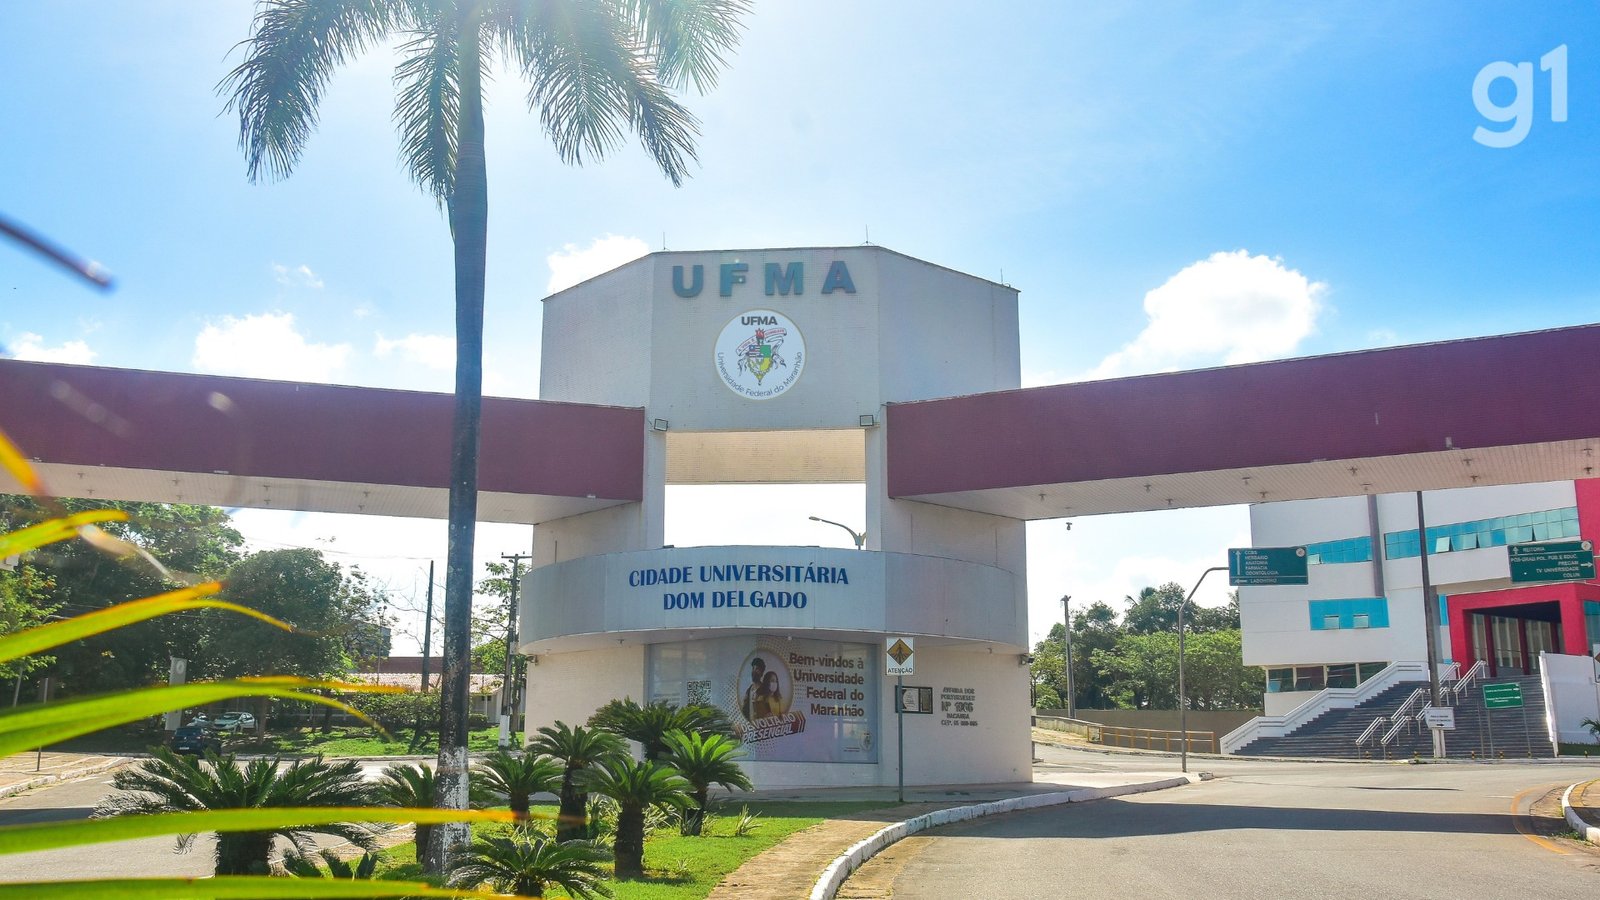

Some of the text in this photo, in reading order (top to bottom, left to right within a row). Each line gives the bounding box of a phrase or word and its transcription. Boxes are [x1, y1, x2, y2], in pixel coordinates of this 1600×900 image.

[672, 261, 857, 298] UFMA
[741, 316, 778, 326] UFMA
[717, 351, 802, 397] Universidade Federal do Maranhão
[628, 562, 849, 587] CIDADE UNIVERSITÁRIA
[663, 590, 808, 610] DOM DELGADO
[788, 653, 864, 669] Bem-vindos à
[793, 669, 864, 685] Universidade
[806, 687, 864, 701] Federal do
[810, 703, 865, 717] Maranhão
[741, 712, 797, 734] DE VOLTA AO
[742, 723, 794, 743] PRESENCIAL
